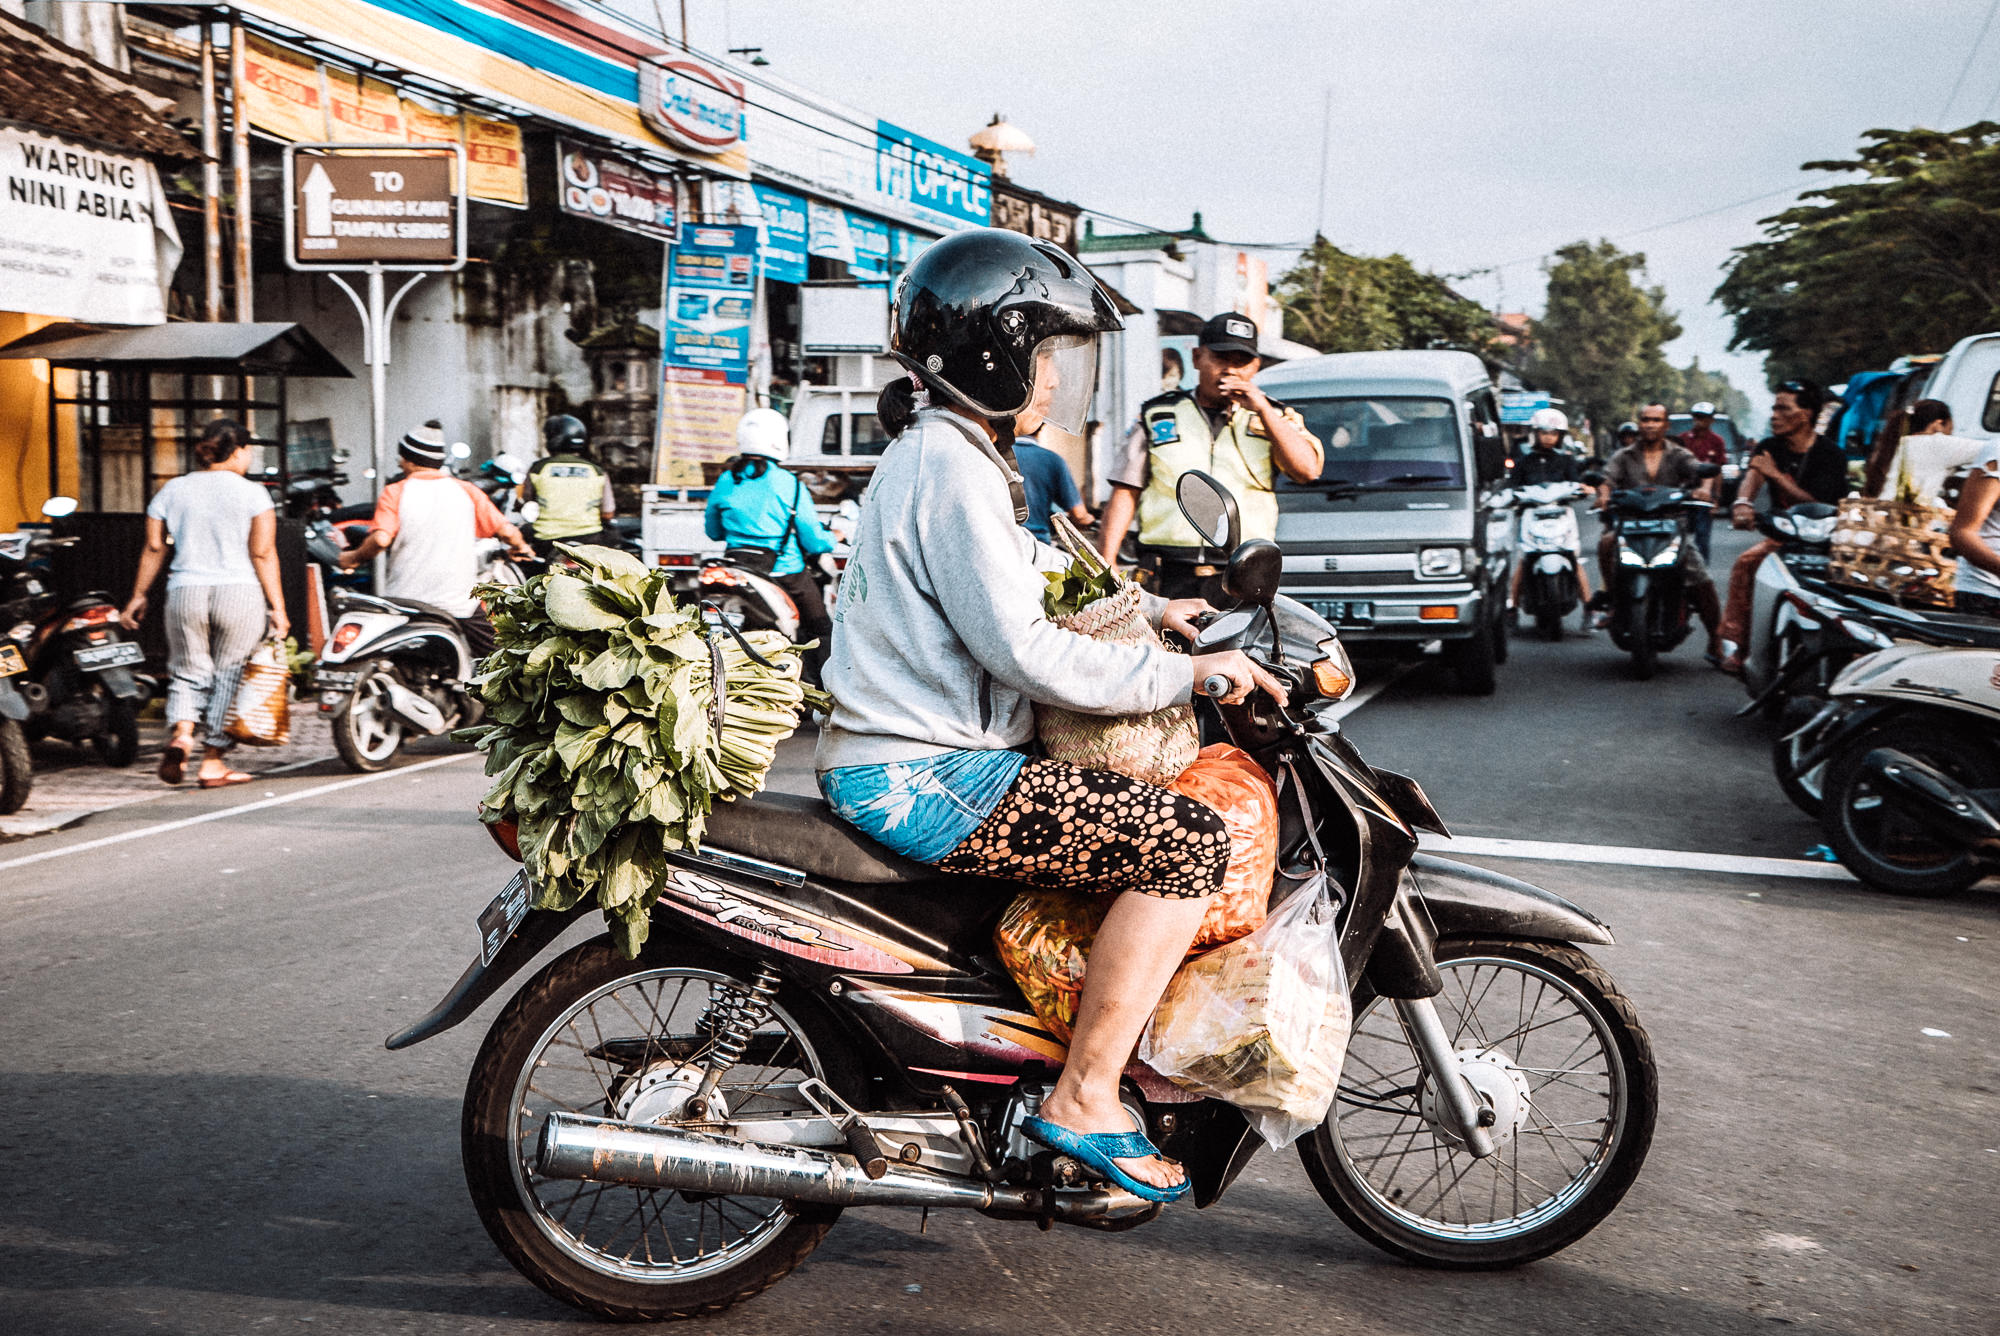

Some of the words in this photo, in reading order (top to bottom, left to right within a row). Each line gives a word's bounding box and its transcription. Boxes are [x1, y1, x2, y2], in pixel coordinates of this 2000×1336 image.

[19, 142, 135, 189] WARUNG
[369, 171, 404, 193] TO
[913, 149, 989, 217] OPPLE
[9, 176, 66, 210] NINI
